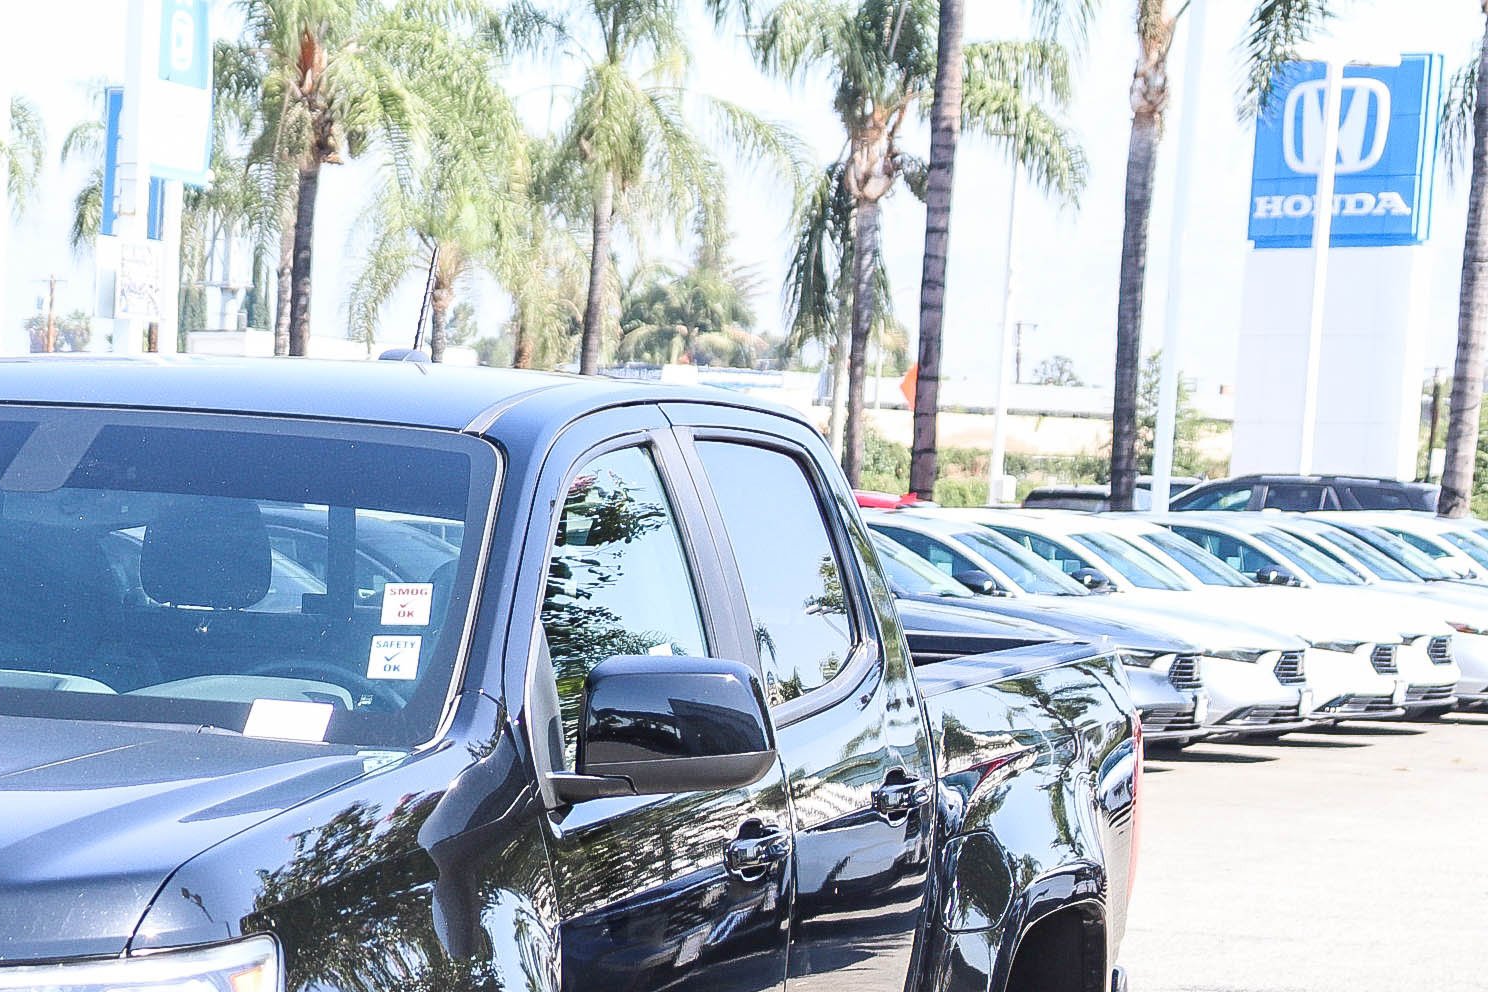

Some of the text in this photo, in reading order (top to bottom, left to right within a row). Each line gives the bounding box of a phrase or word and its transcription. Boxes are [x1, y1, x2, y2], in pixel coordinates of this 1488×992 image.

[389, 587, 429, 596] SMOG
[396, 610, 415, 618] OK
[375, 640, 416, 649] SAFETY
[383, 664, 401, 672] OK
